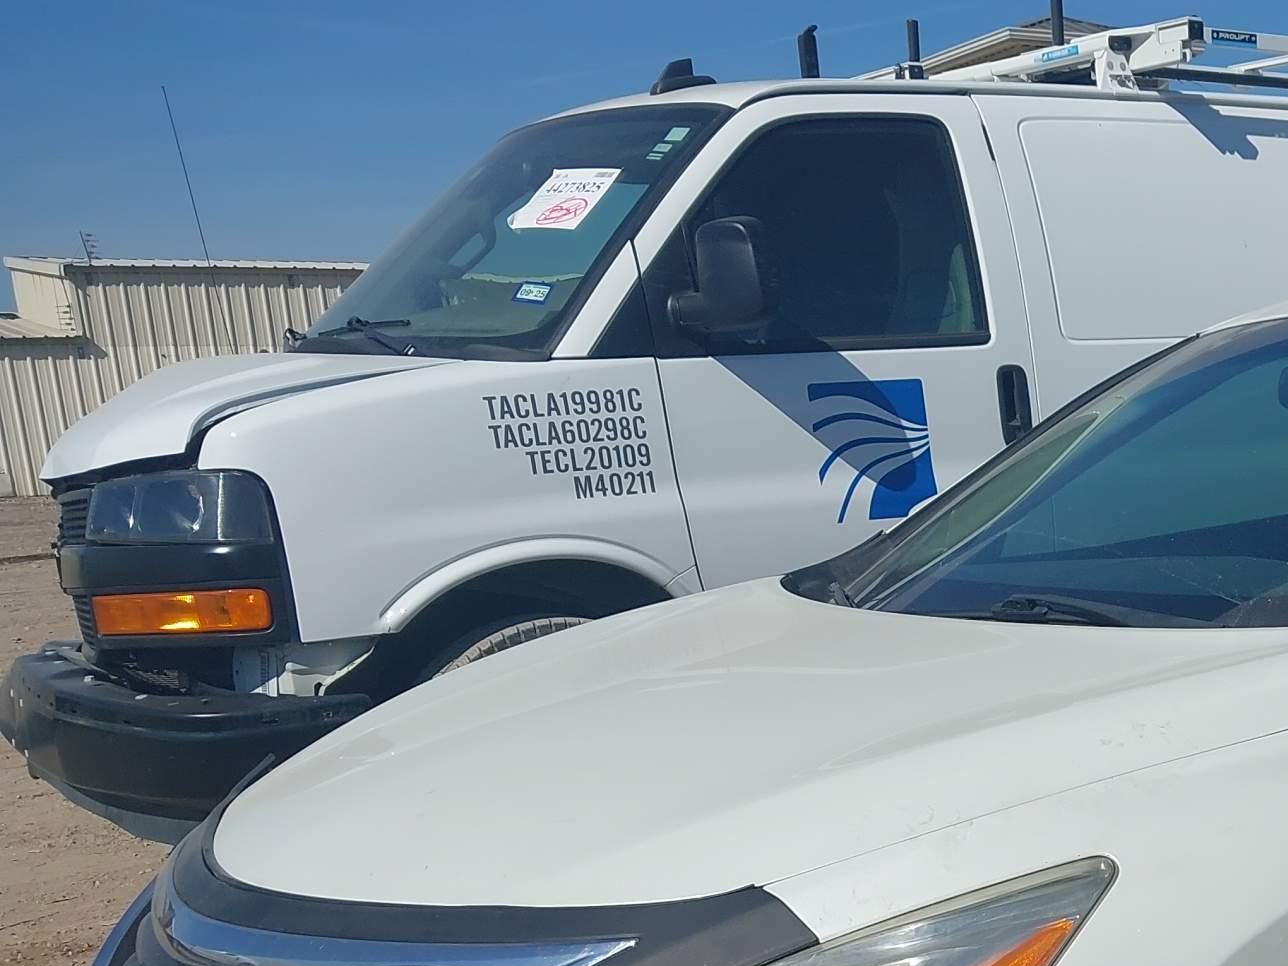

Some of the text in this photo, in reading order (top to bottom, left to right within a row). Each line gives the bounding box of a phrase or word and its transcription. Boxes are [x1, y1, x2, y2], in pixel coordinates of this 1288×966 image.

[545, 181, 605, 194] 44273825
[482, 387, 643, 420] TACLA19981C
[488, 415, 647, 449] TACLA60298C
[525, 443, 652, 475] TECL20109
[573, 470, 656, 500] M40211
